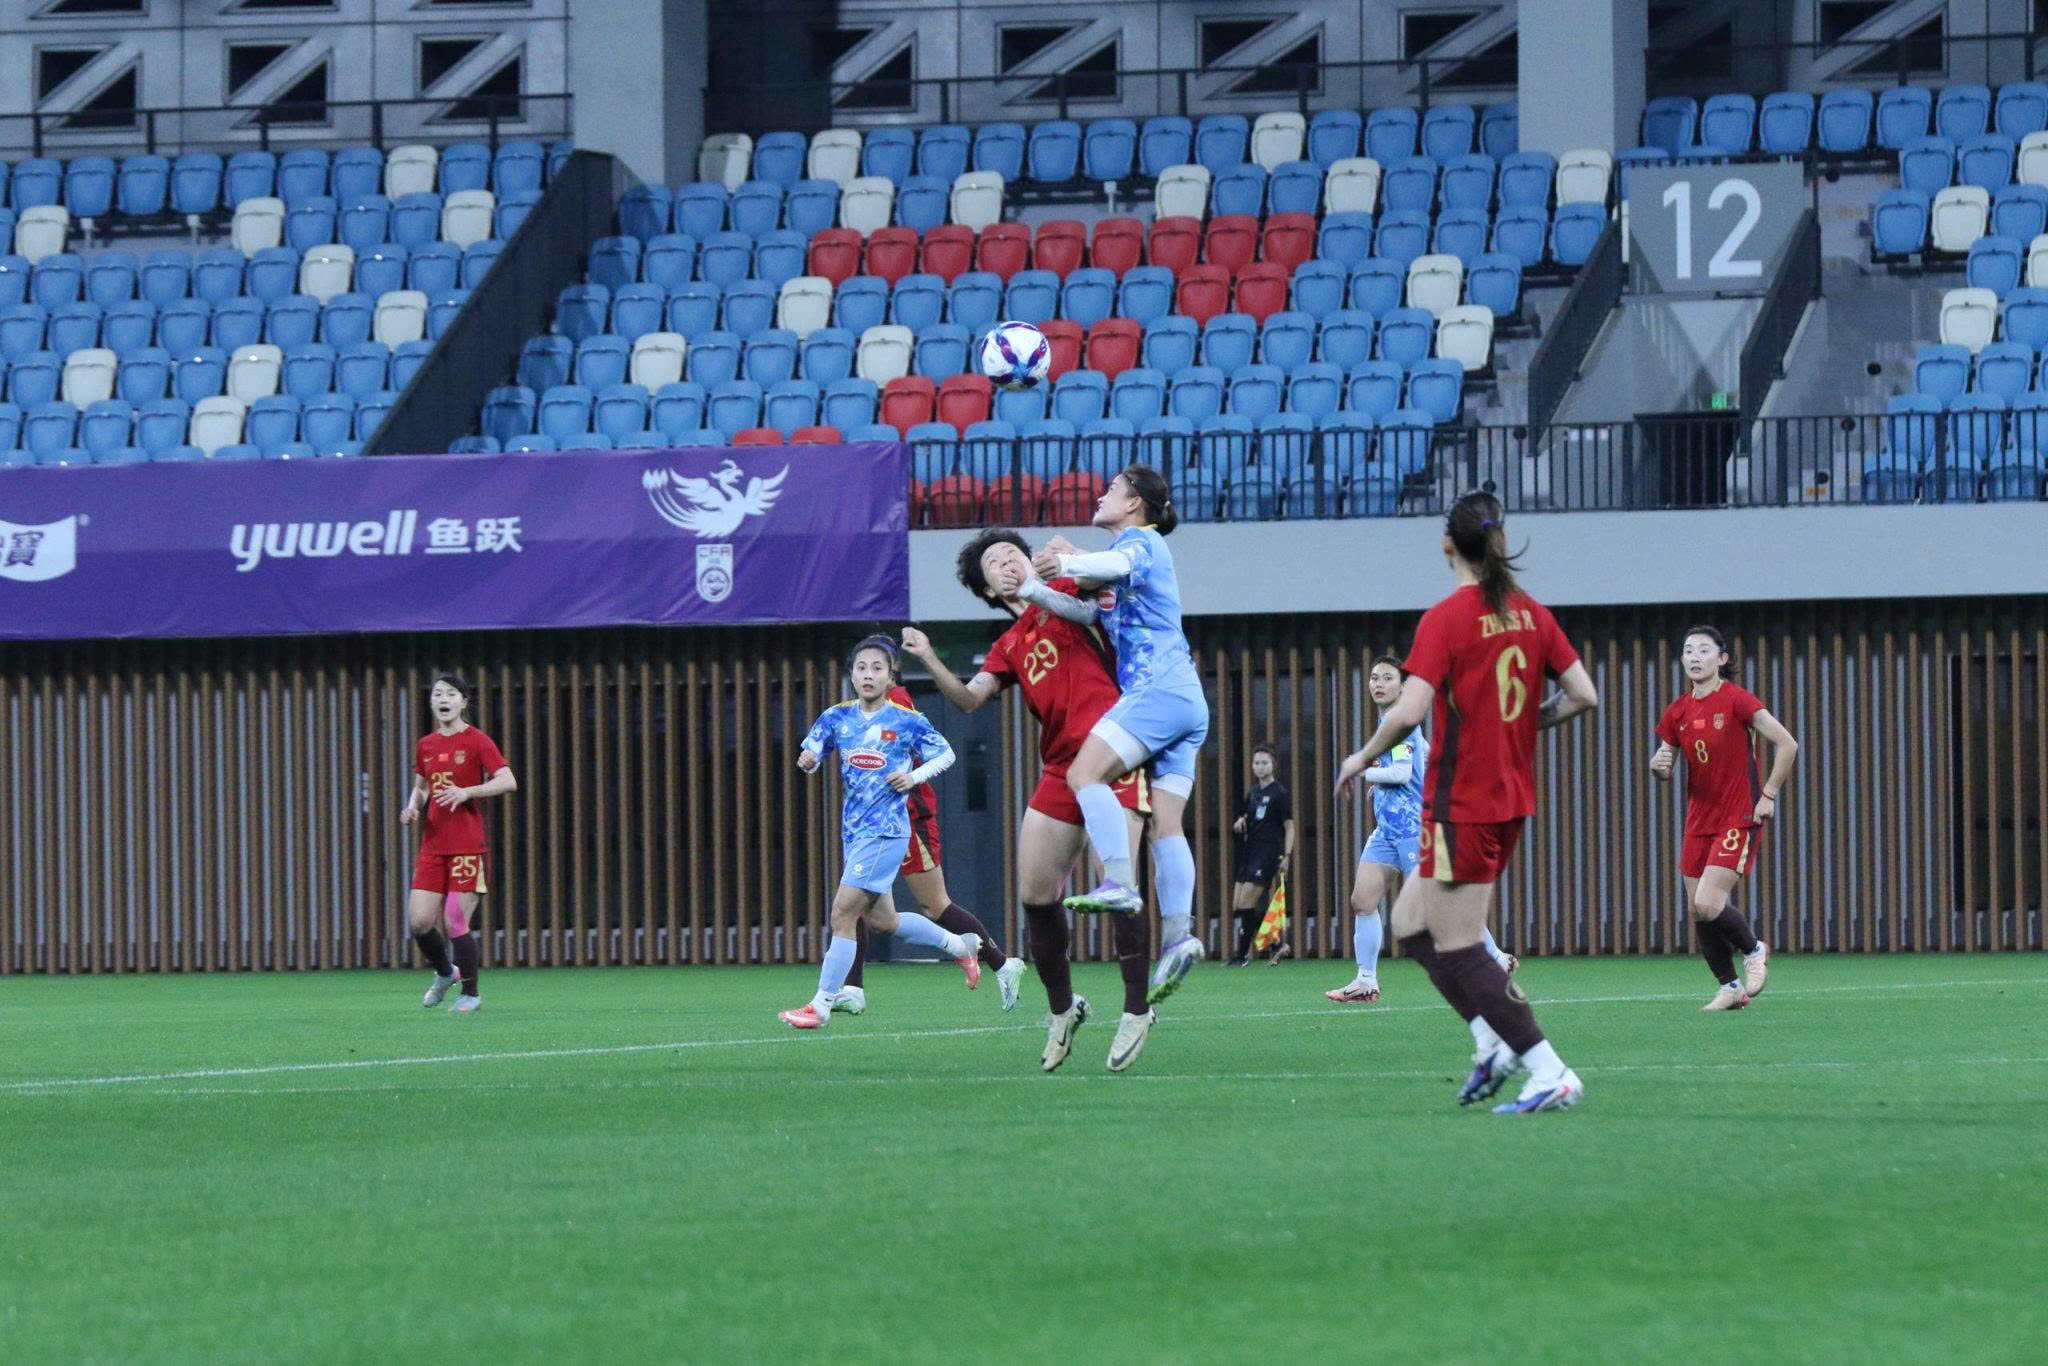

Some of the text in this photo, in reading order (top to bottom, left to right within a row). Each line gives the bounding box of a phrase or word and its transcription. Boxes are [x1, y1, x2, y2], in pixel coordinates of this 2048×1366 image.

[1663, 178, 1762, 279] 12
[229, 509, 523, 572] yuwell 鱼跃
[1023, 638, 1058, 686] 29
[1496, 644, 1527, 722] 6
[1695, 739, 1708, 763] 8
[1722, 828, 1740, 850] 8
[451, 855, 477, 877] 25
